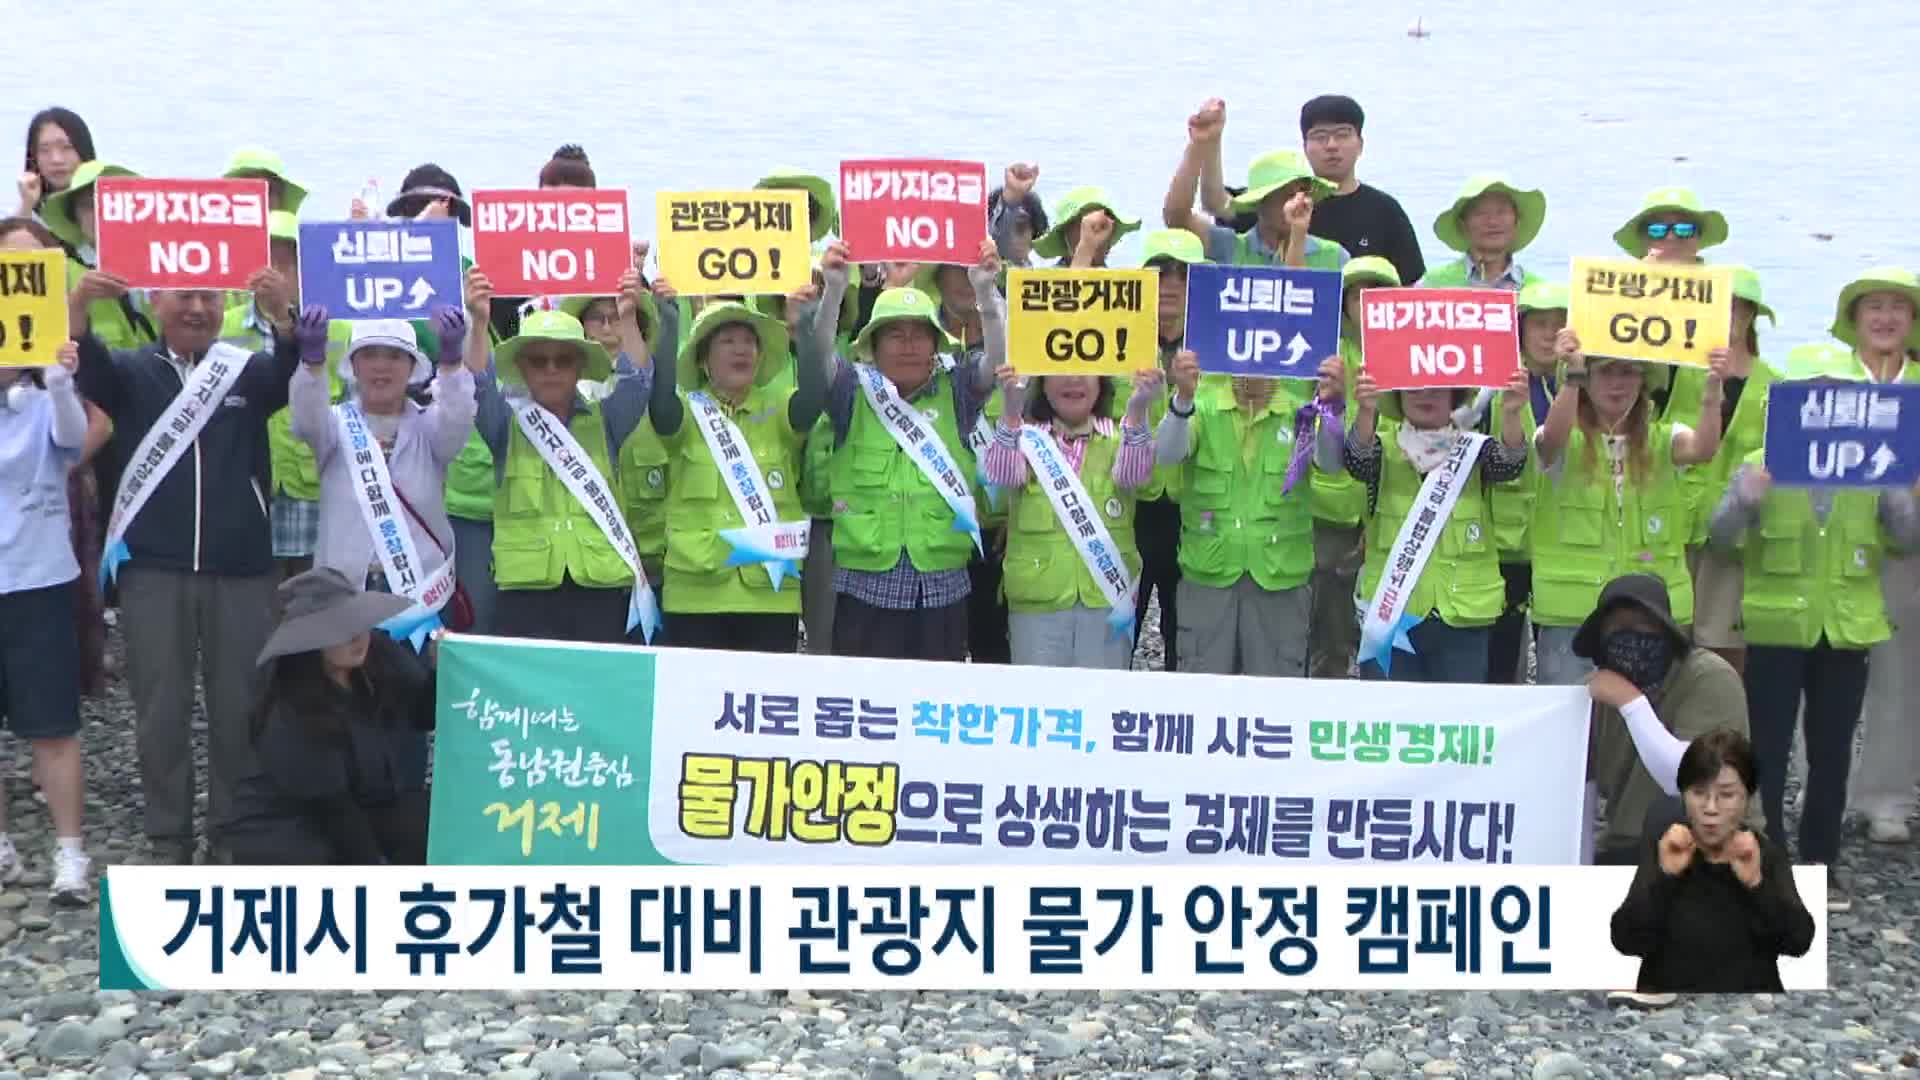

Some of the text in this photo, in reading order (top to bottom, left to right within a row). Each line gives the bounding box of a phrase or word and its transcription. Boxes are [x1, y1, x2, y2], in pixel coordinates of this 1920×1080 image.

[845, 171, 984, 206] 바가지요금
[102, 191, 267, 228] 바가지요금
[478, 202, 626, 235] 바가지요금
[671, 200, 792, 232] 관광거제
[331, 228, 433, 265] 신뢰는
[345, 277, 401, 312] UP
[1021, 279, 1142, 312] 관광거제
[1219, 277, 1315, 314] 신뢰는
[1587, 269, 1712, 305] 관광거제
[1366, 301, 1513, 334] 바가지요금
[1228, 329, 1282, 363] UP
[1800, 390, 1900, 428] 신뢰는
[1808, 441, 1865, 478] UP
[1060, 492, 1098, 538] 다함께
[714, 690, 1496, 766] 서로 돕는 착한가격, 함께 사는 민생경제!
[678, 752, 1516, 864] 물가안정으로 상생하는 경제를 만듭시다!
[482, 798, 600, 857] 거제
